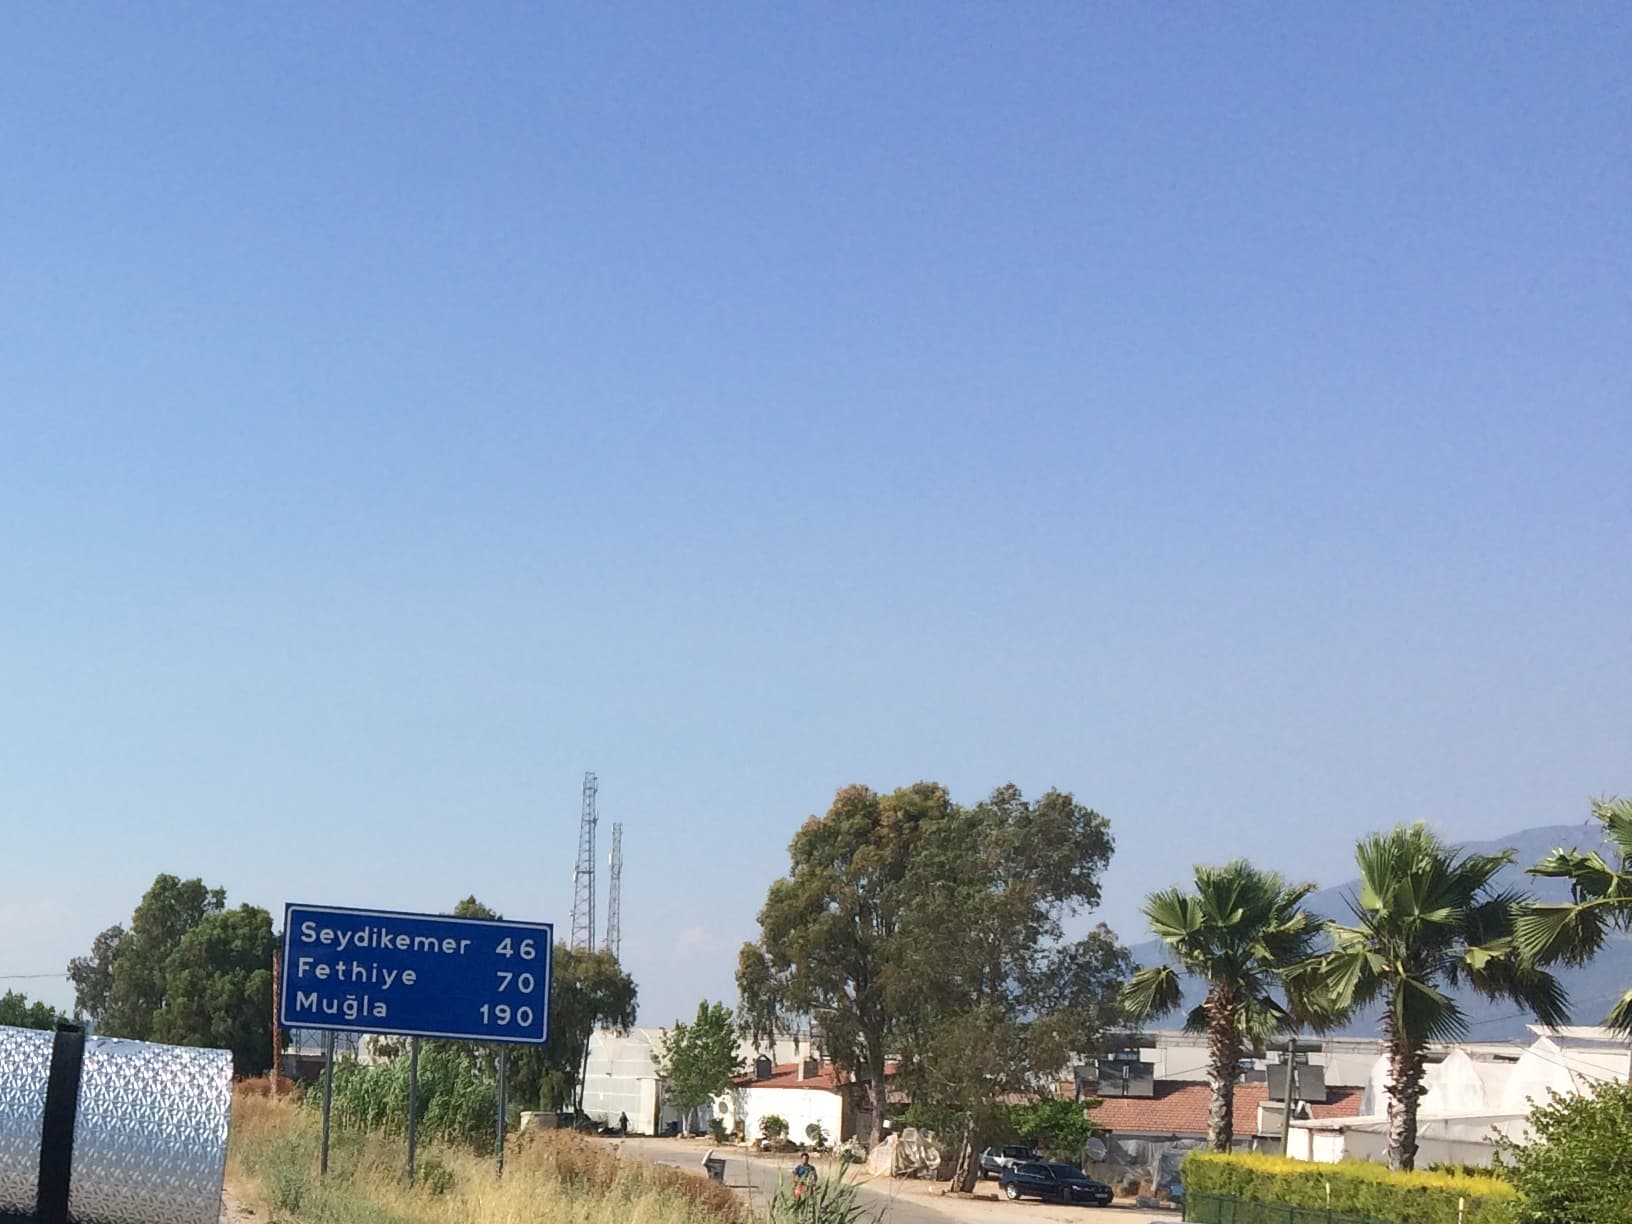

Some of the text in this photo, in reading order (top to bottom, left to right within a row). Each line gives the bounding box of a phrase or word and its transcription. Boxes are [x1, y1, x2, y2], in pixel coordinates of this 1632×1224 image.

[301, 921, 536, 960] Seydikemer 46
[298, 957, 535, 994] Fethiye 70
[296, 991, 534, 1027] Muğla 190
